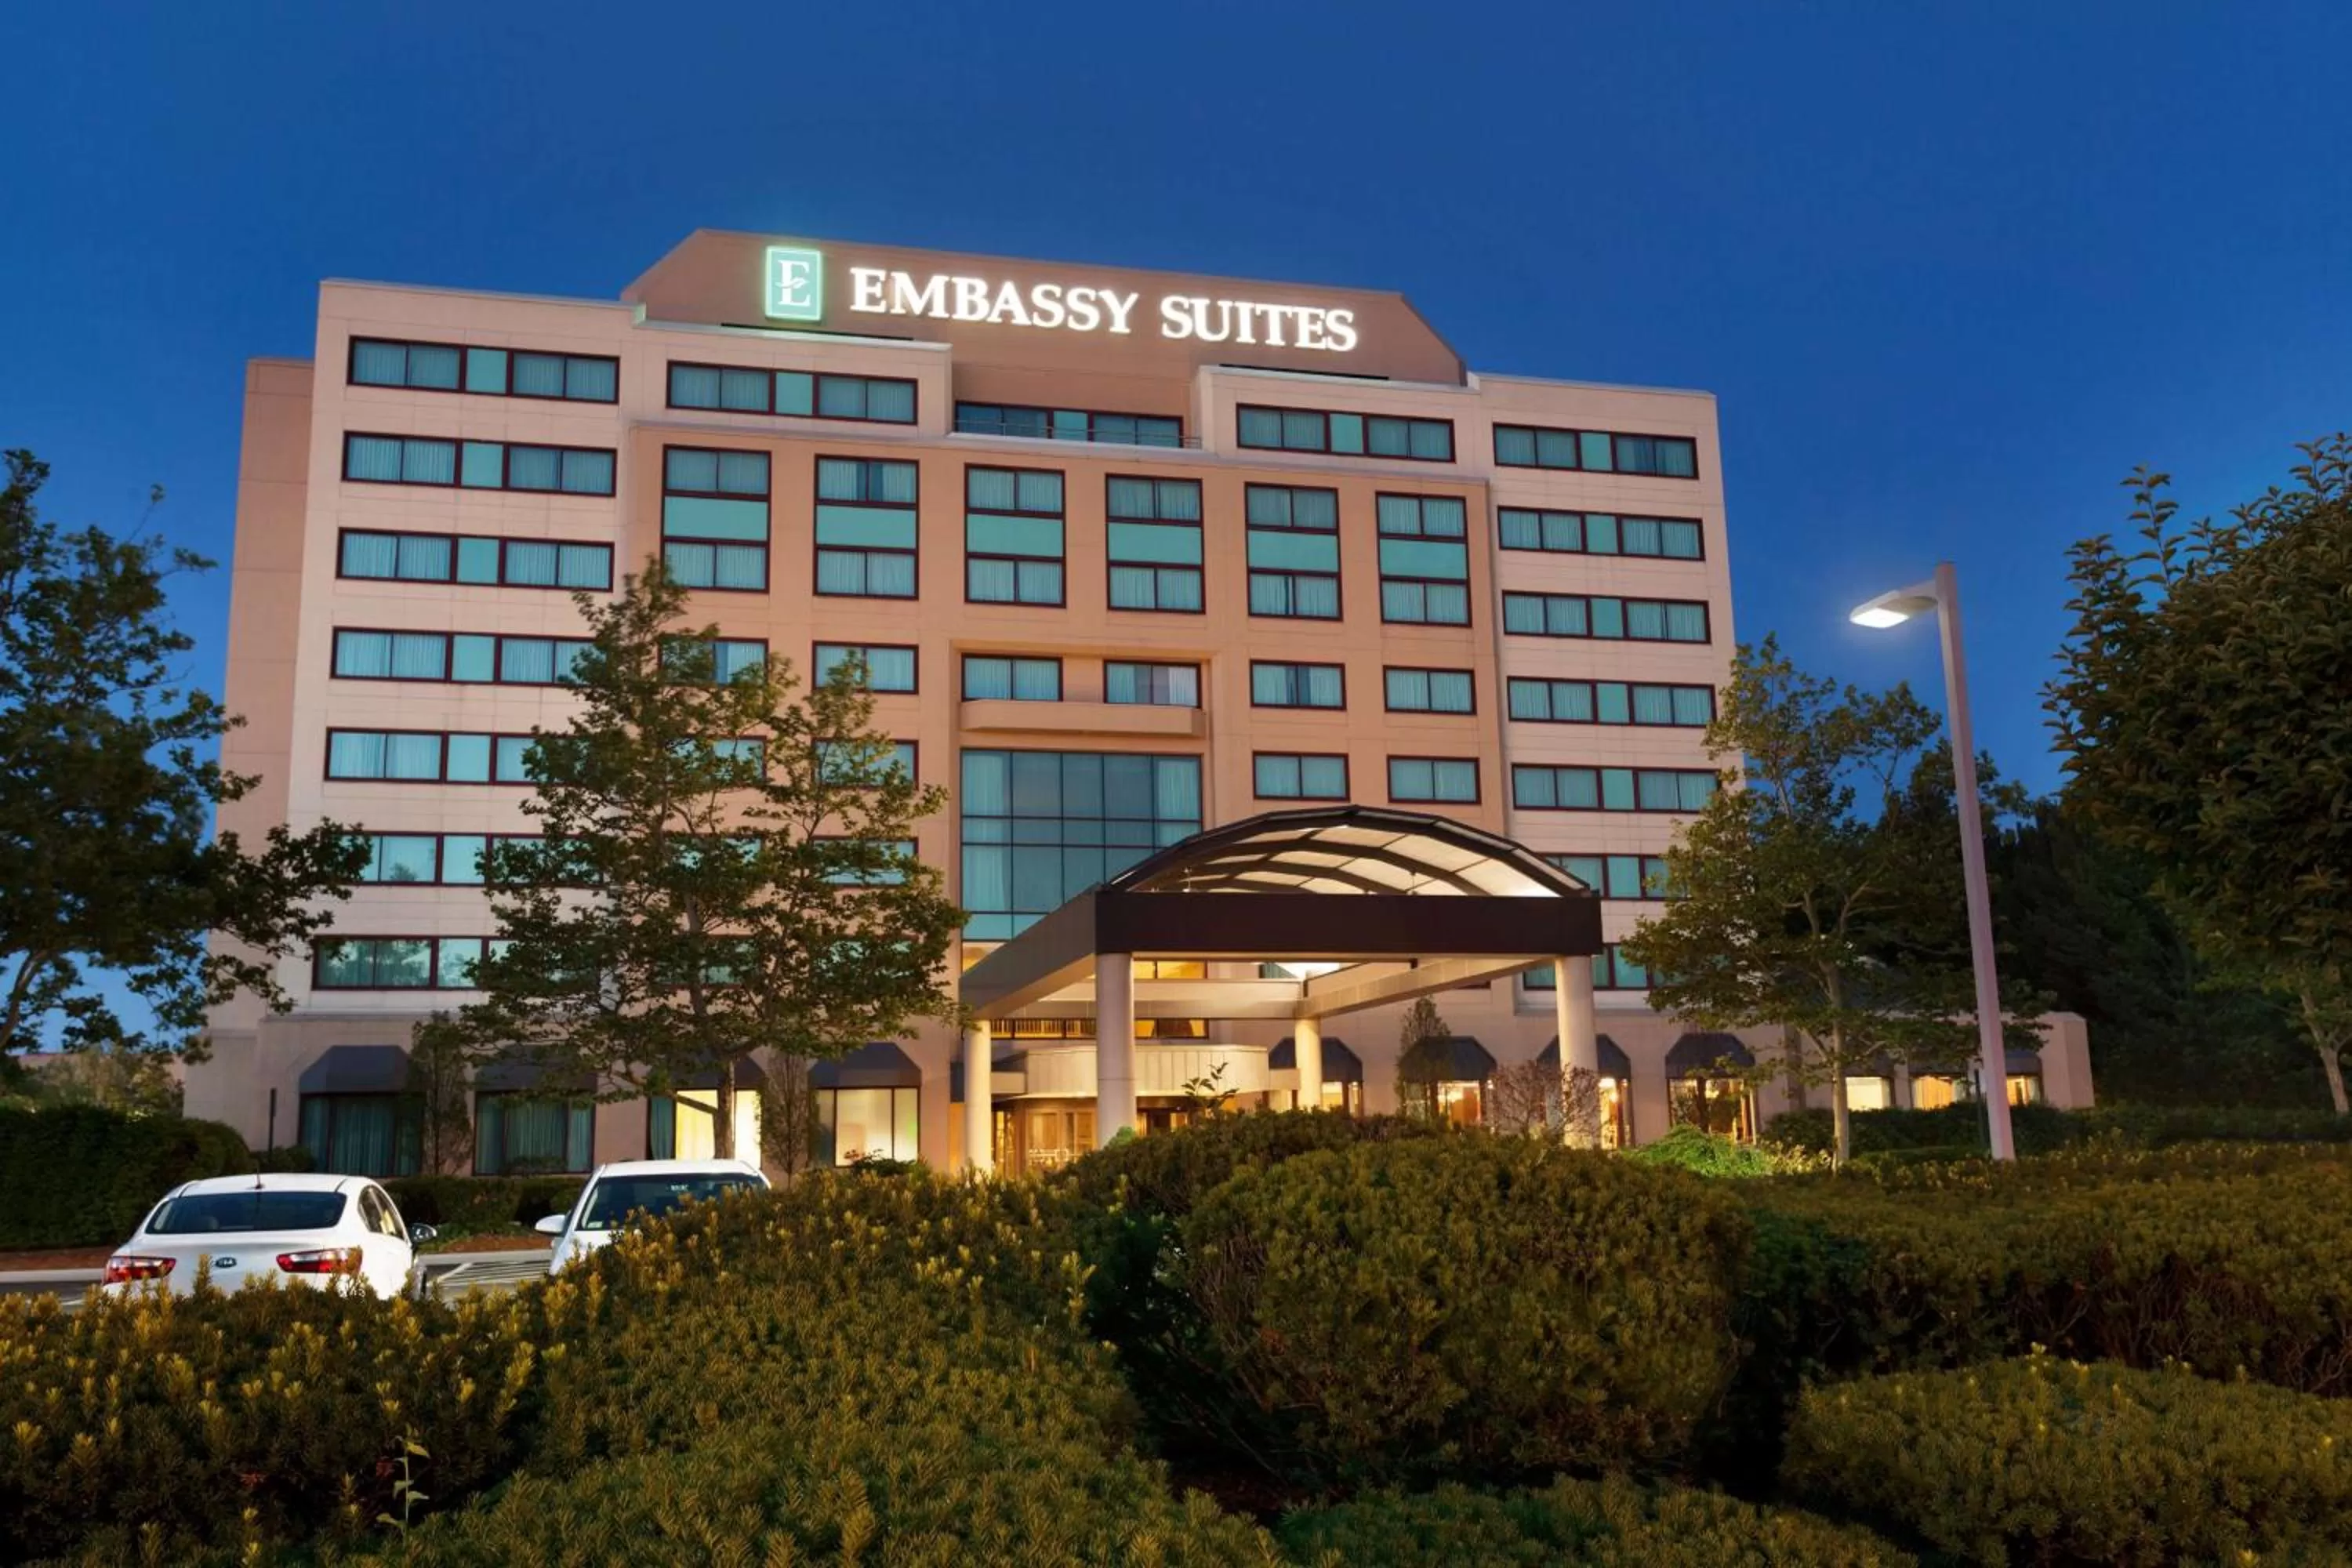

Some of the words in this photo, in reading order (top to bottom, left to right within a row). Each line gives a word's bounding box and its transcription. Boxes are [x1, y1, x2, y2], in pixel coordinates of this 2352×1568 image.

[776, 260, 811, 307] E
[850, 267, 1138, 333] EMBASSY
[1160, 295, 1357, 351] SUITES
